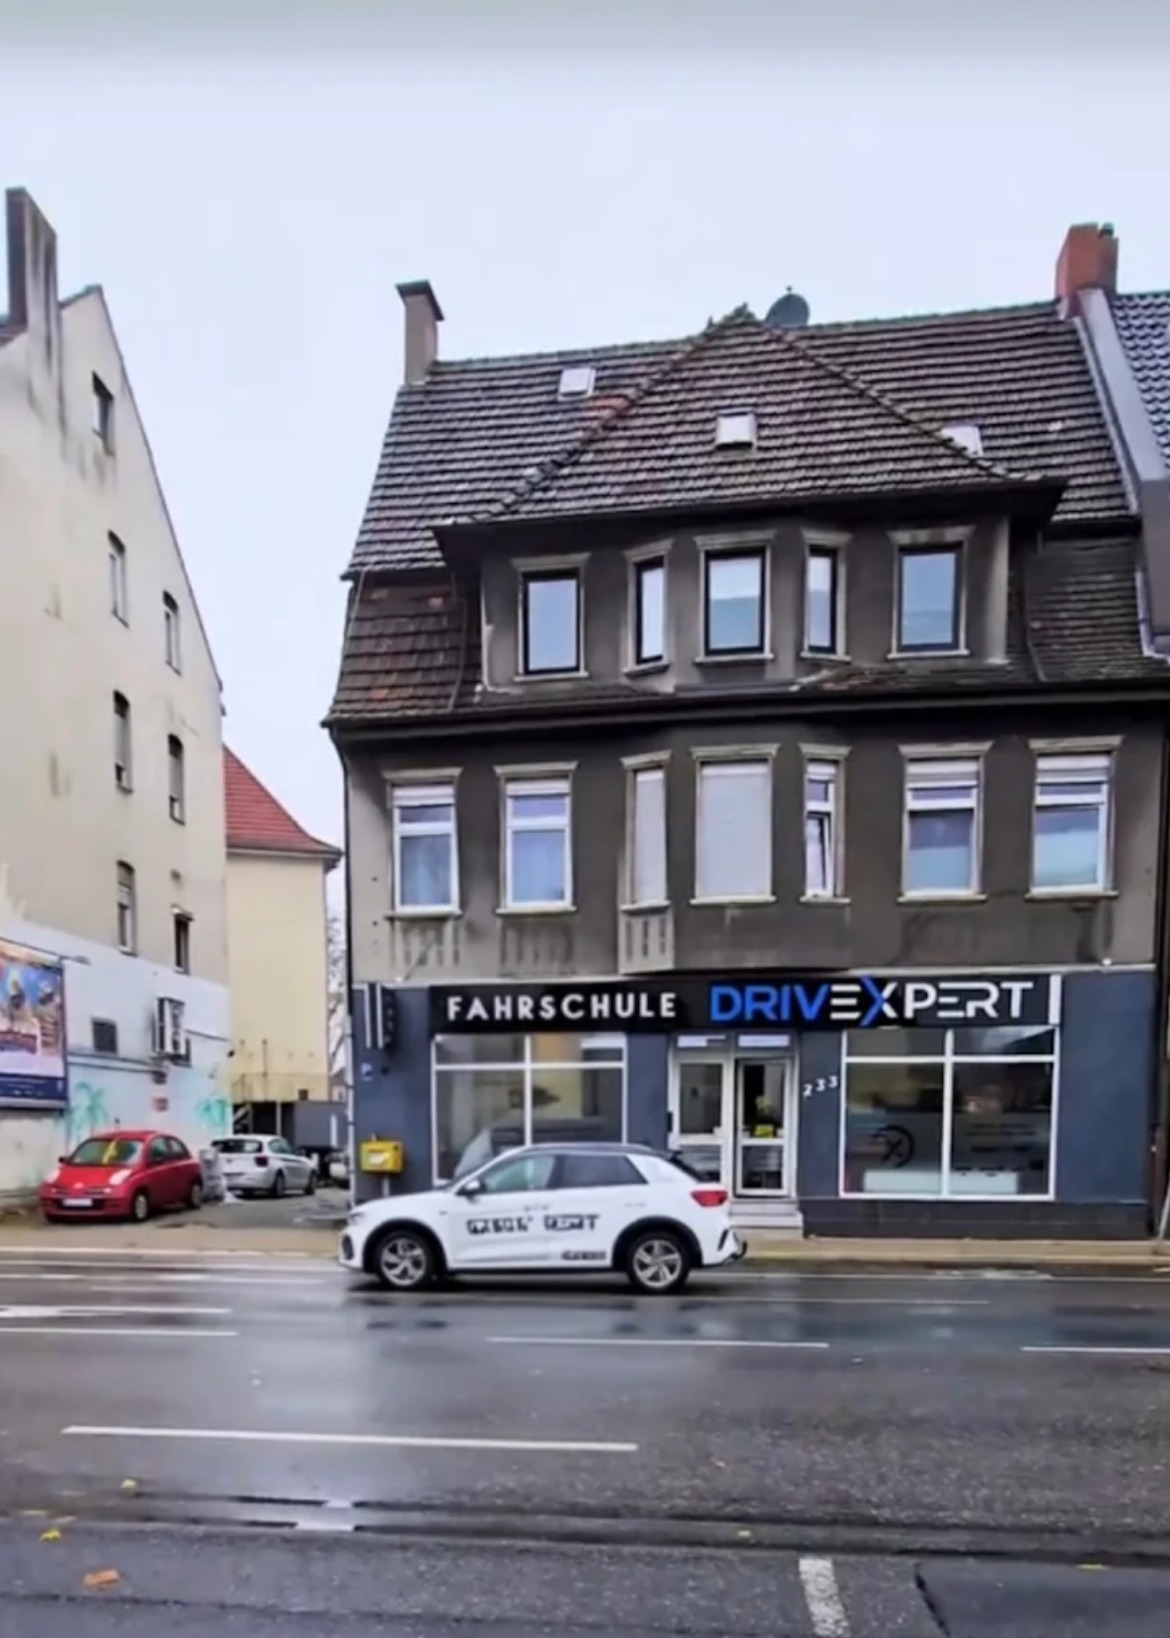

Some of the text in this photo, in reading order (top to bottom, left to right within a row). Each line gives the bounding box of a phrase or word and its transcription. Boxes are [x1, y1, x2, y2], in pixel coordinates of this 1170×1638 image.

[447, 975, 1033, 1026] FAHRSCHULE DRIVEXPERT
[802, 1075, 839, 1098] 233
